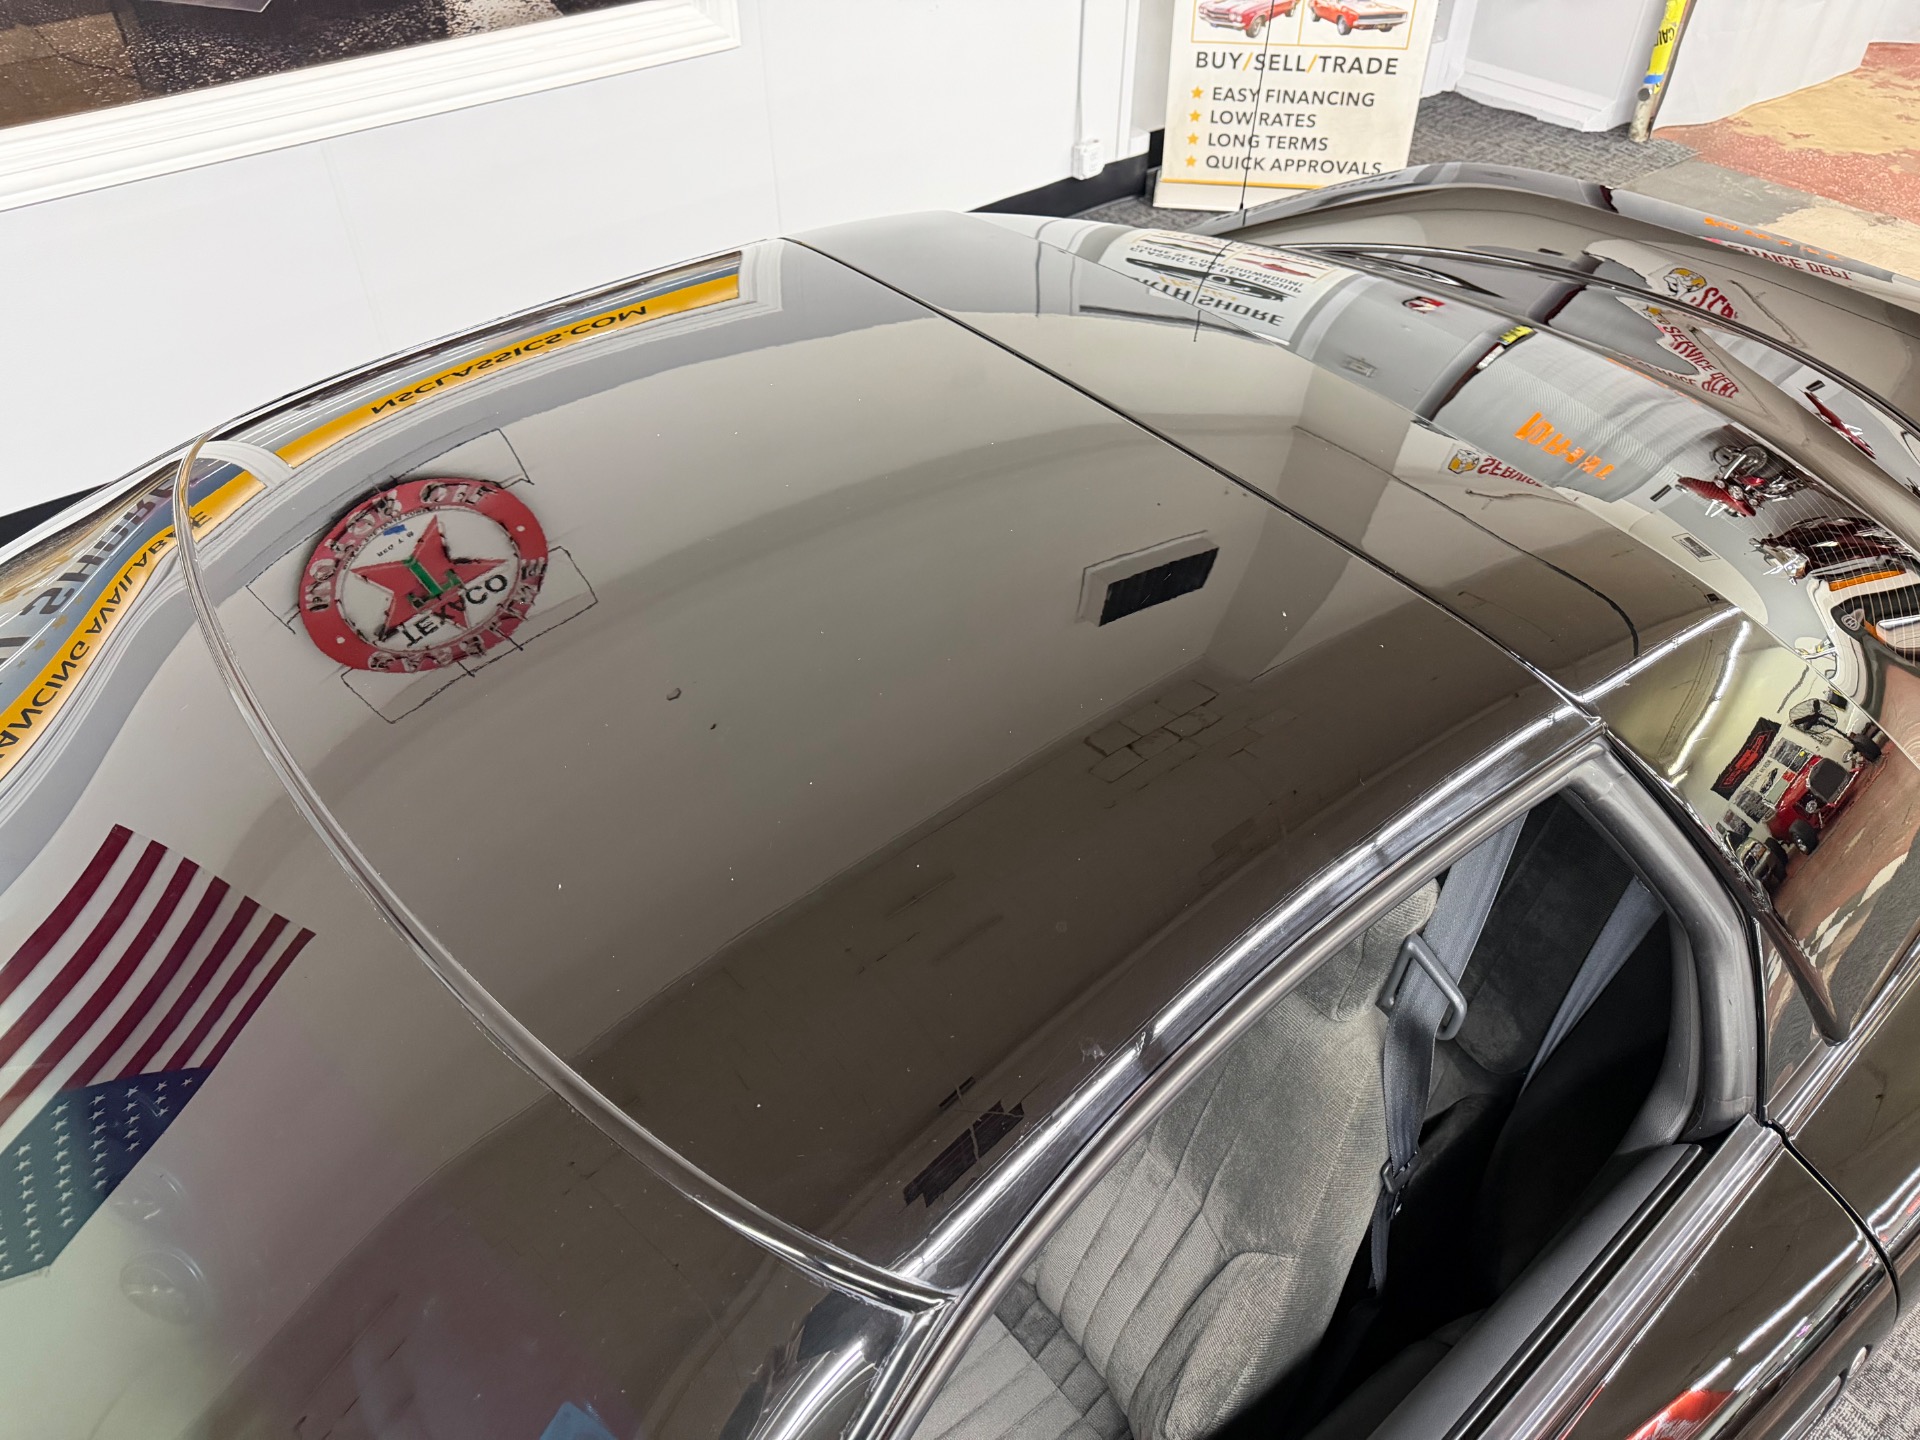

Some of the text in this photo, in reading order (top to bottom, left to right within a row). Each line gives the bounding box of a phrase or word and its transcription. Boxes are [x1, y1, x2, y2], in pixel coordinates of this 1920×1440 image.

[1212, 86, 1376, 108] EASY FINANCING
[1210, 109, 1317, 129] LOW RATES
[1208, 132, 1329, 152] LONG TERMS
[1205, 155, 1382, 176] QUICK APPROVALS
